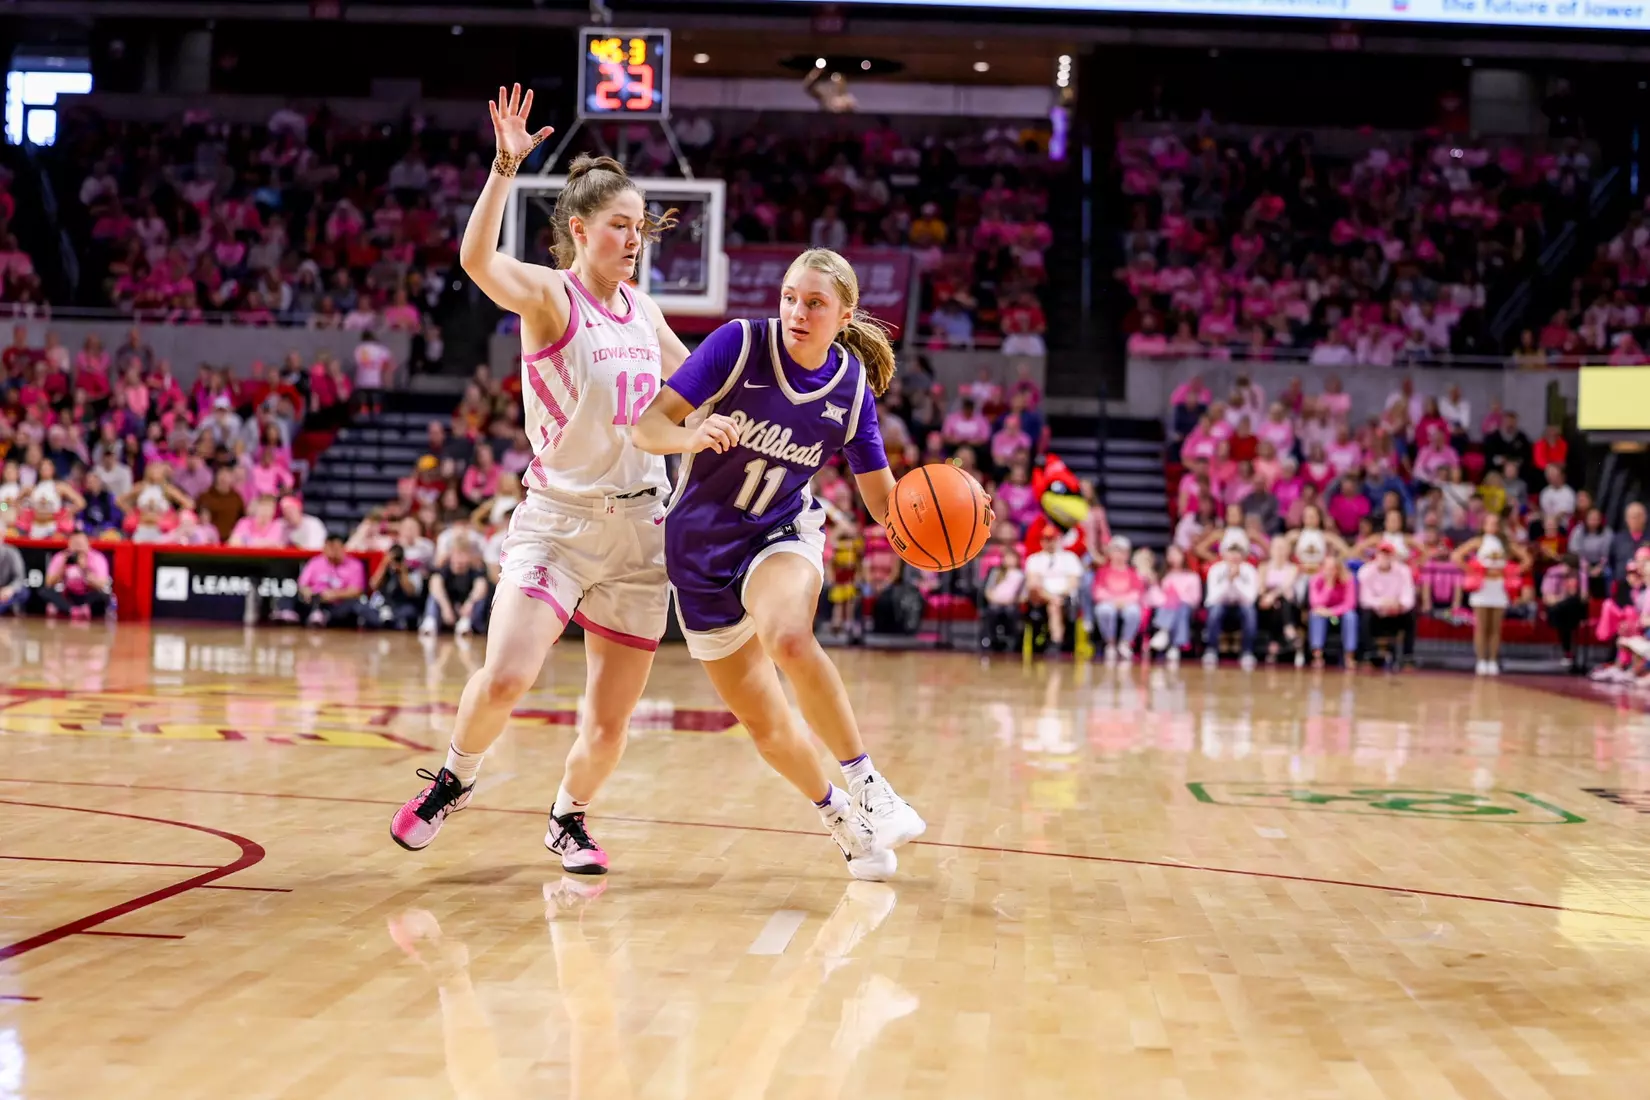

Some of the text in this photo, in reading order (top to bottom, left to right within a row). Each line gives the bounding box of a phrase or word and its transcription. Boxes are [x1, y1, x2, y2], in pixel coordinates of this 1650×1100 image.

[1484, 0, 1548, 16] future
[1555, 1, 1577, 16] of
[1584, 1, 1643, 18] lower
[596, 63, 653, 110] 23
[592, 347, 627, 363] IOWA
[612, 371, 656, 426] 12
[730, 410, 824, 467] Wildcats
[733, 458, 787, 517] 11
[192, 575, 297, 597] LEARFELD
